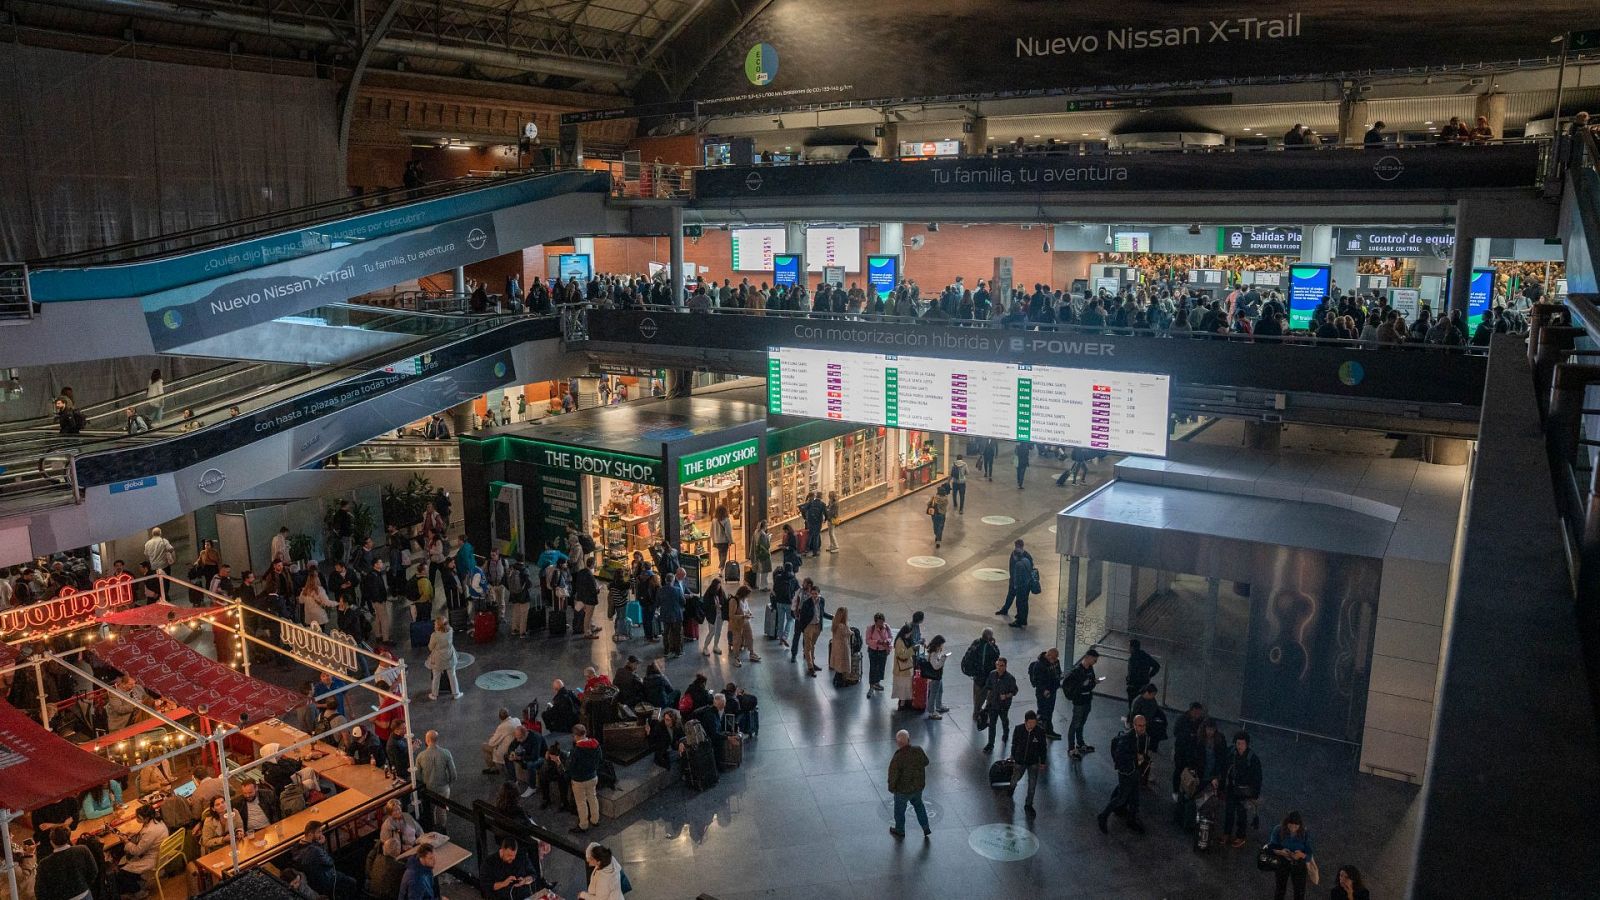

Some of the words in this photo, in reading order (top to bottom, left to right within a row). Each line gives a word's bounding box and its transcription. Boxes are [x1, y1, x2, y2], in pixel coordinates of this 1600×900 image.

[1015, 36, 1100, 58] Nuevo
[1107, 26, 1201, 51] Nissan
[1207, 12, 1302, 43] X-Trail
[931, 167, 950, 184] Tu
[954, 165, 1014, 184] familia,
[1019, 166, 1038, 182] tu
[1042, 165, 1128, 182] aventura
[204, 254, 241, 271] ¿Quién
[242, 250, 261, 263] dijo
[263, 246, 281, 258] que
[367, 223, 382, 235] por
[384, 211, 425, 227] descubrir?
[1250, 232, 1284, 242] Salidas
[1369, 233, 1406, 244] Control
[1409, 234, 1422, 244] de
[362, 263, 376, 274] Tu
[375, 255, 407, 271] familia,
[407, 254, 418, 262] tu
[419, 242, 455, 259] aventura
[210, 293, 260, 315] Nuevo
[264, 280, 311, 300] Nissan
[315, 266, 356, 286] X-Trail
[794, 325, 823, 339] Con
[826, 328, 928, 345] motorización
[931, 331, 989, 350] híbrida
[992, 339, 1004, 353] y
[255, 420, 275, 433] Con
[275, 409, 302, 426] hasta
[303, 406, 310, 416] 7
[309, 396, 340, 414] plazas
[340, 389, 360, 404] para
[360, 378, 385, 394] todas
[385, 375, 400, 386] tus
[545, 451, 573, 468] THE
[575, 454, 611, 472] BODY
[684, 461, 703, 475] THE
[705, 453, 732, 472] BODY
[124, 480, 144, 490] global
